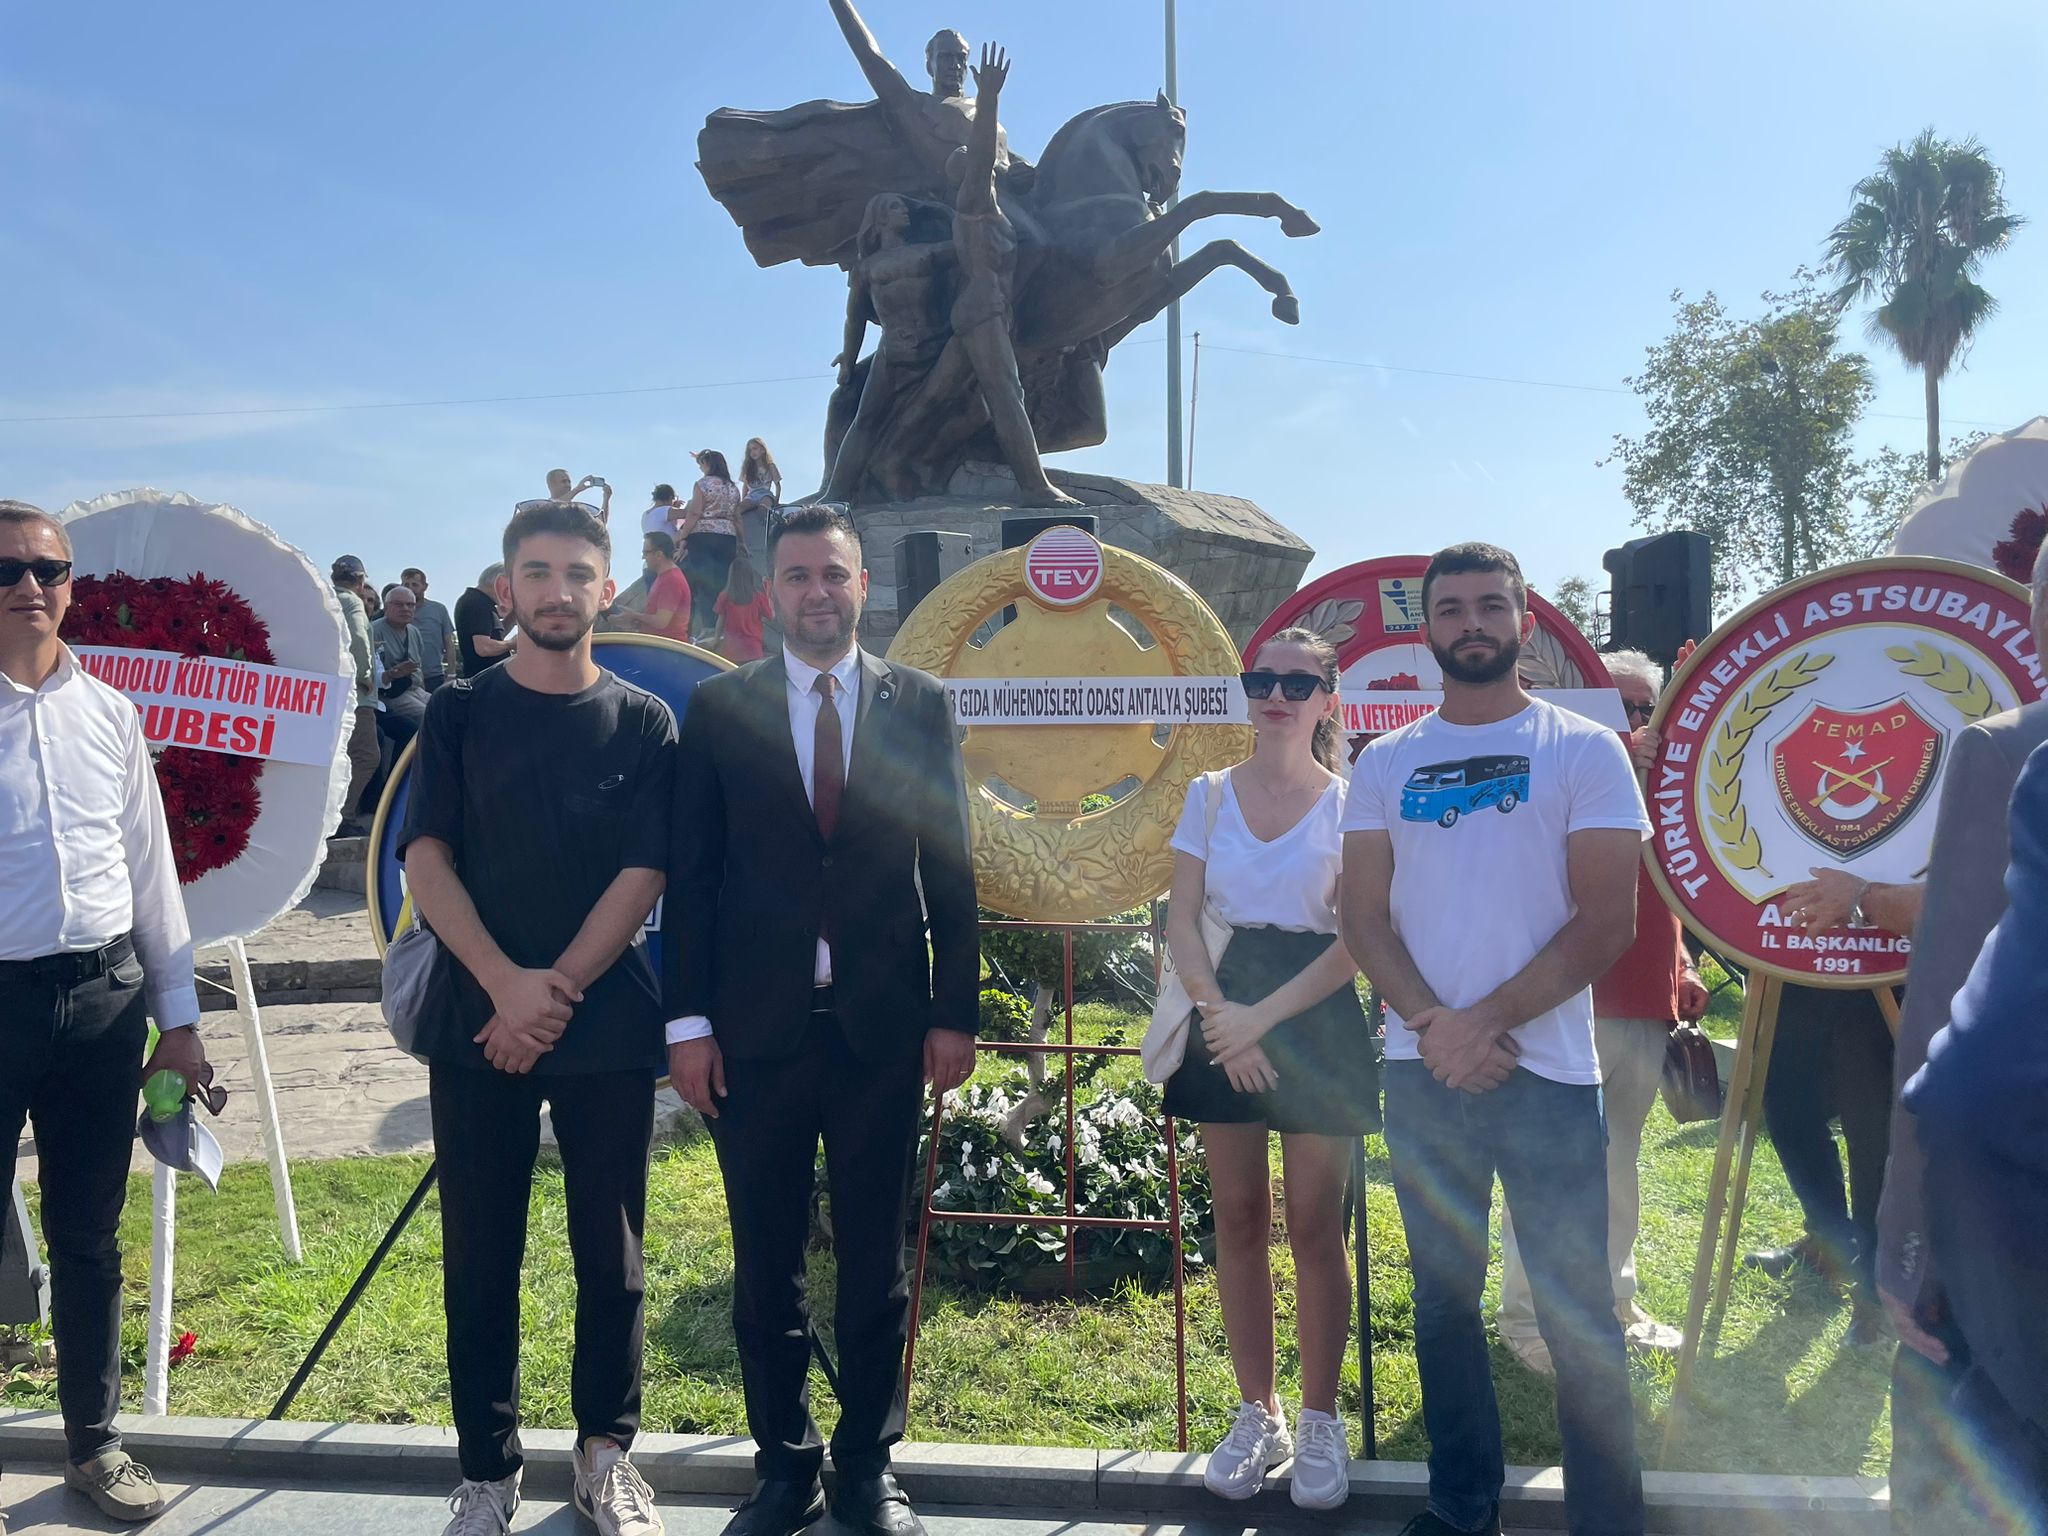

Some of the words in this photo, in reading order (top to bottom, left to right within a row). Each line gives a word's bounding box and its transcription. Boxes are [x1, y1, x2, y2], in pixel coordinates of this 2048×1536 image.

[1035, 569, 1094, 586] TEV
[1803, 585, 2048, 701] ASTSUBAYLA
[172, 657, 260, 708] KÜLTÜR
[263, 673, 328, 716] VAKFI
[1677, 612, 1791, 733] EMEKLİ
[960, 688, 990, 717] GIDA
[993, 680, 1084, 717] MÜHENDİSLERİ
[1086, 687, 1125, 717] ODASI
[1127, 687, 1182, 716] ANTALYA
[1184, 679, 1229, 723] ŞUBESİ
[135, 703, 276, 756] UBESİ
[1812, 714, 1907, 738] TEMAD
[1653, 741, 1710, 900] TÜRKİYE
[1822, 794, 1913, 847] ASTSUBAYLAR
[1834, 823, 1862, 832] 1984
[1761, 930, 1781, 949] İL
[1786, 934, 1912, 954] BAŞKANLIĞ
[1812, 957, 1861, 973] 1991
